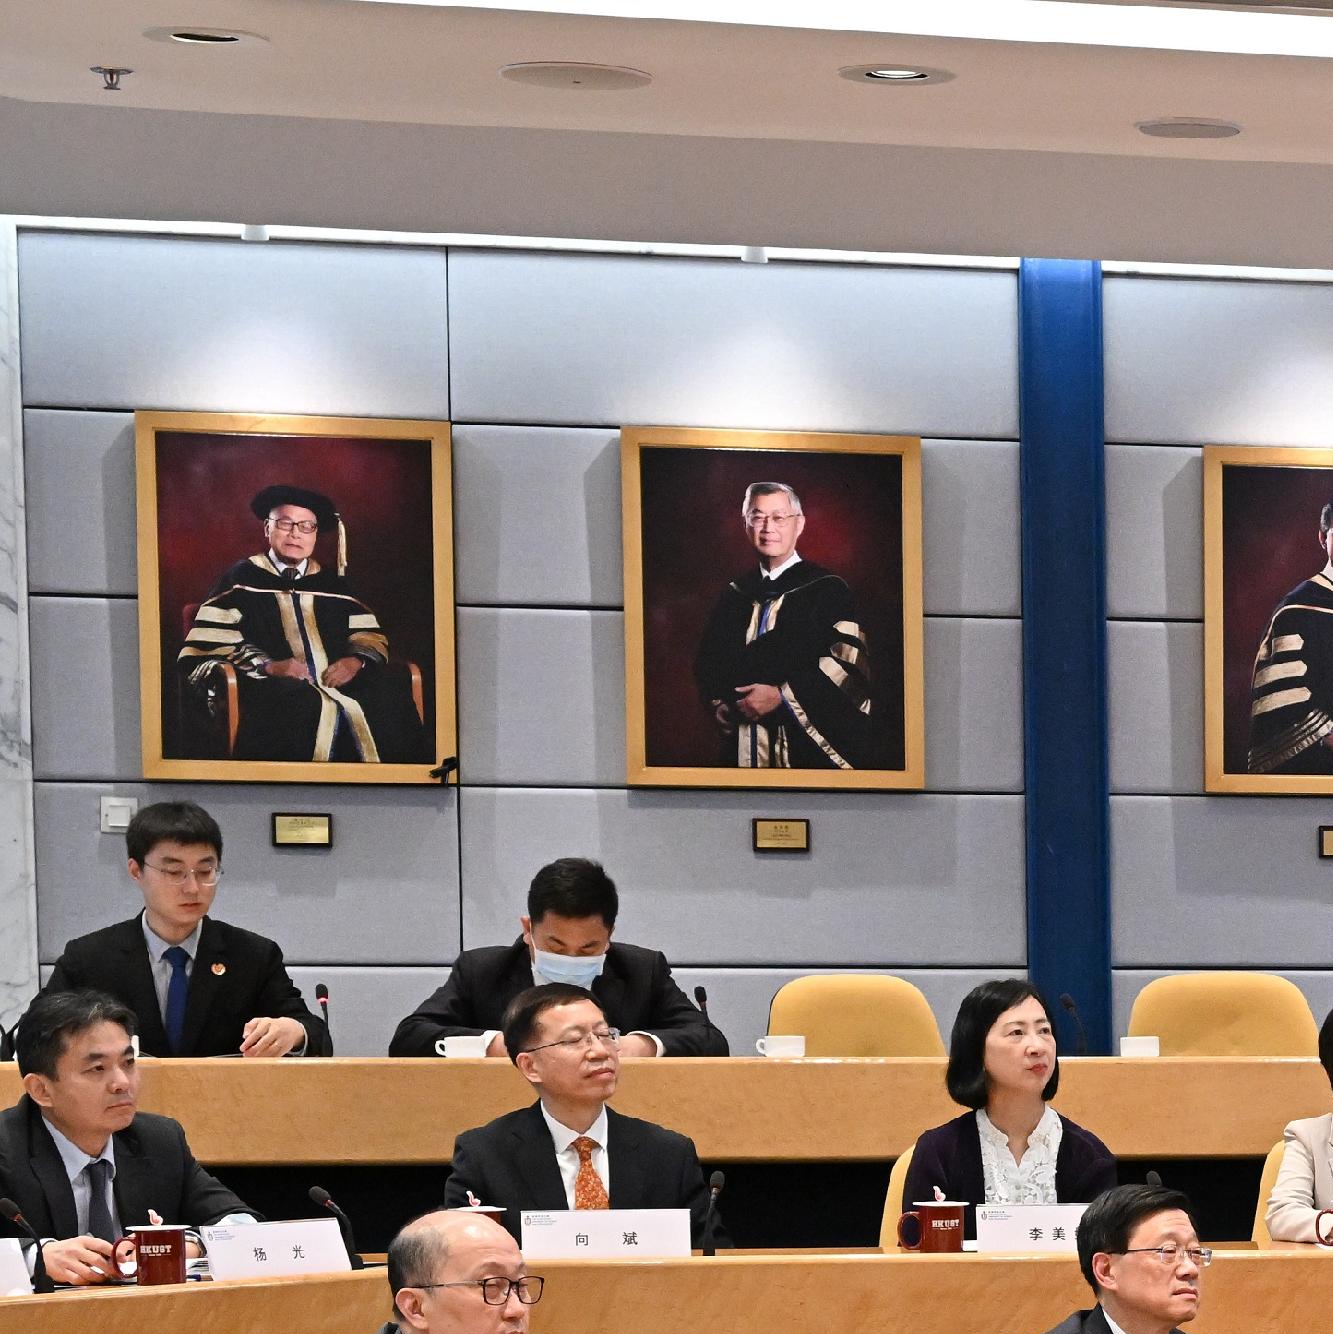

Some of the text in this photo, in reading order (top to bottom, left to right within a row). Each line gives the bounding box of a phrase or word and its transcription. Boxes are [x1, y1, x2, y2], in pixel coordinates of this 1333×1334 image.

[932, 1218, 960, 1228] HKUST
[575, 1231, 639, 1246] 向斌
[1029, 1226, 1079, 1241] 李美
